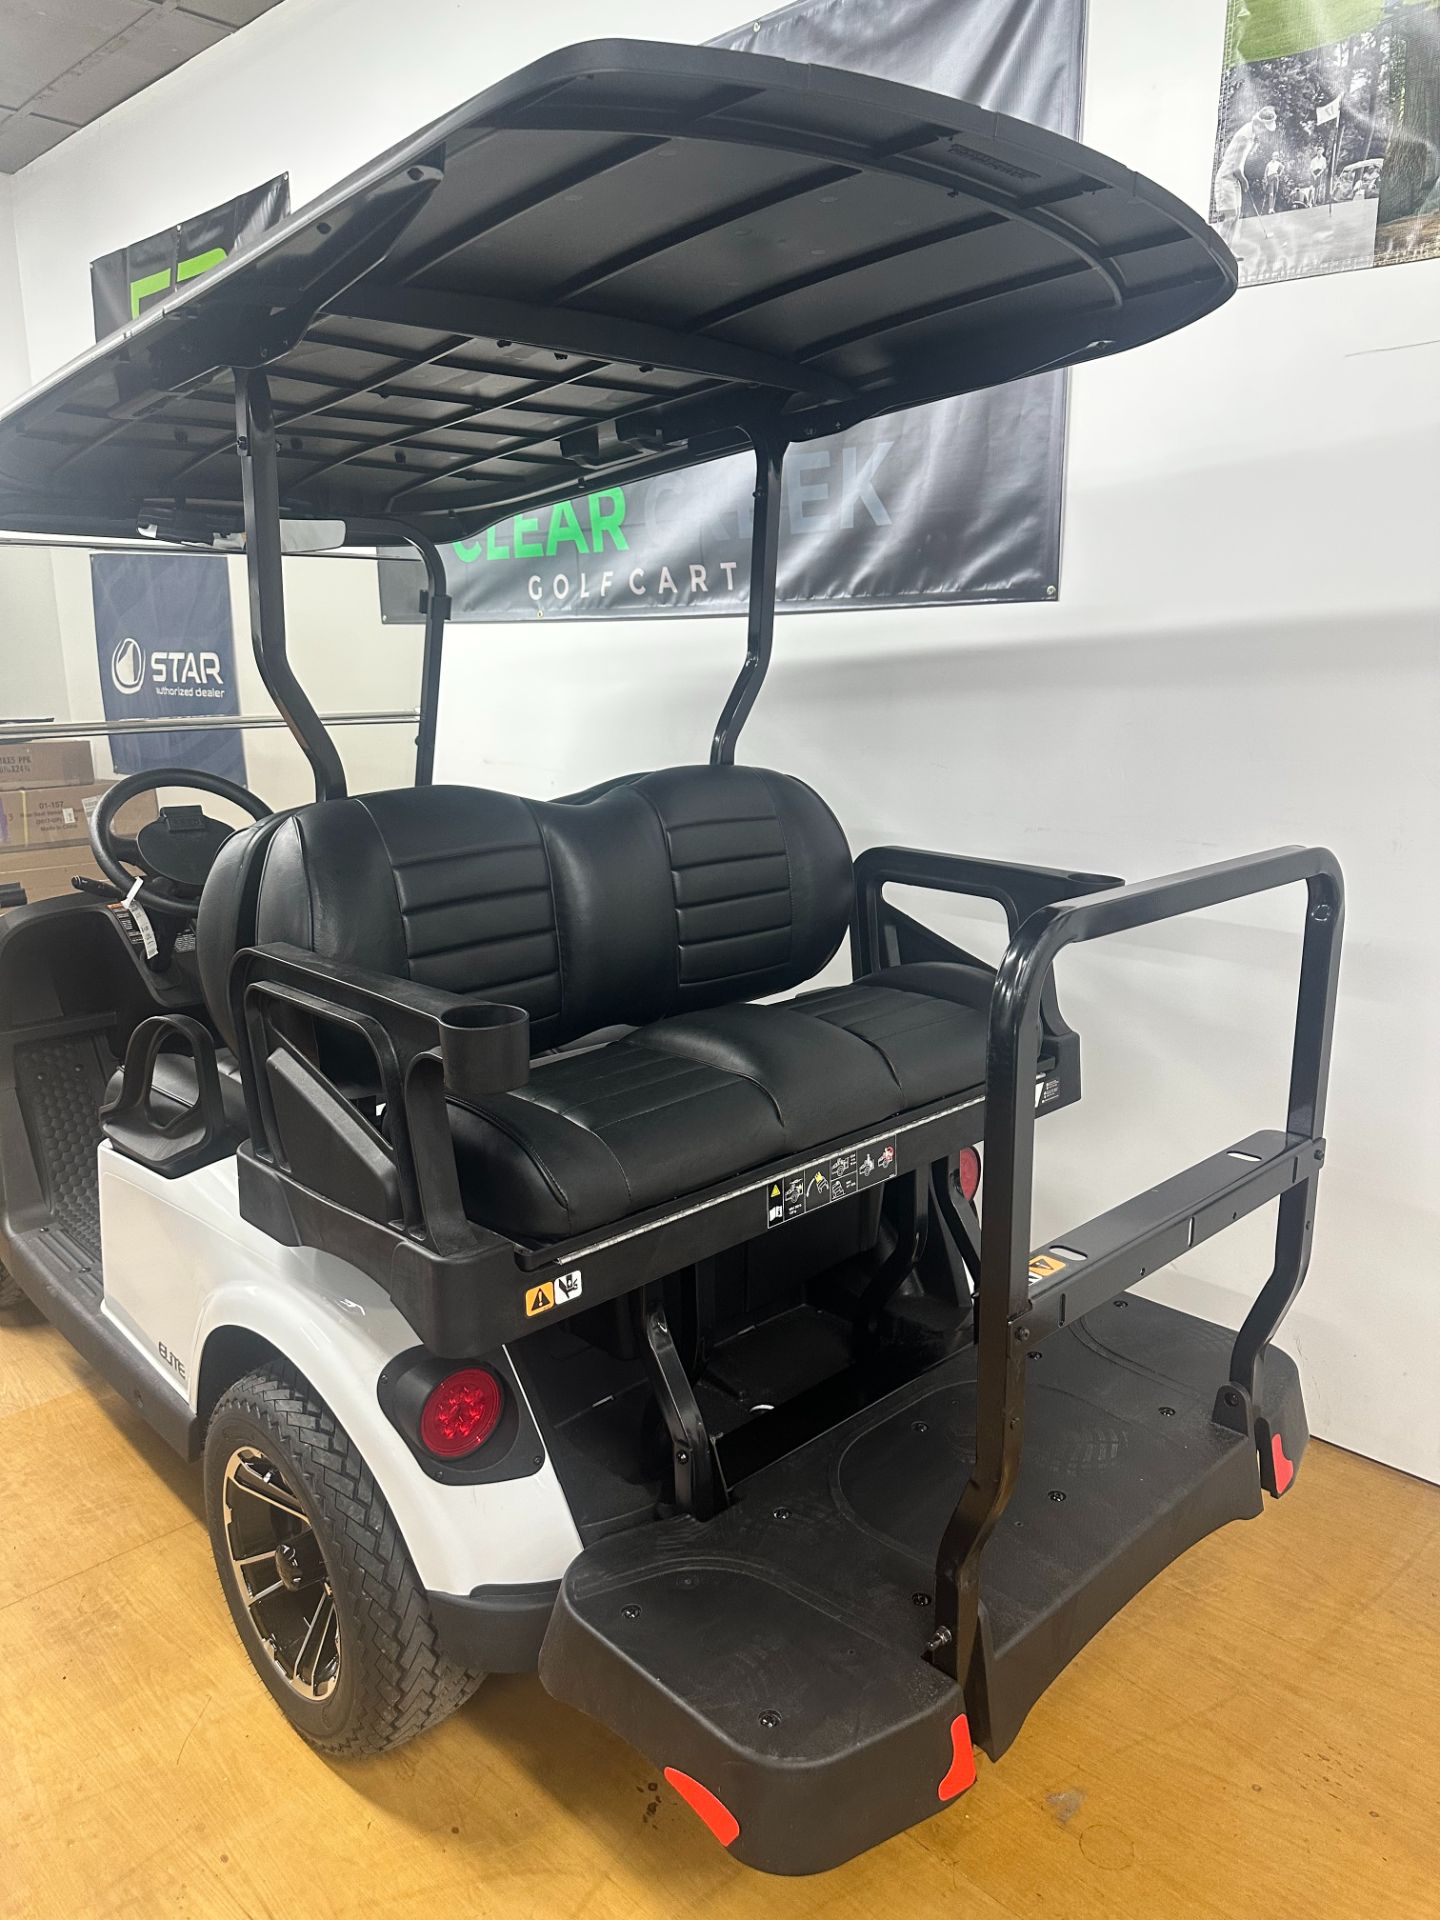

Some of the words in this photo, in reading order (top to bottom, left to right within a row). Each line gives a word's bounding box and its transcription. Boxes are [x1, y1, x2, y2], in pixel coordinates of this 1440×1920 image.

[643, 441, 895, 546] CEK
[151, 652, 224, 684] STAR
[195, 687, 225, 698] dealer
